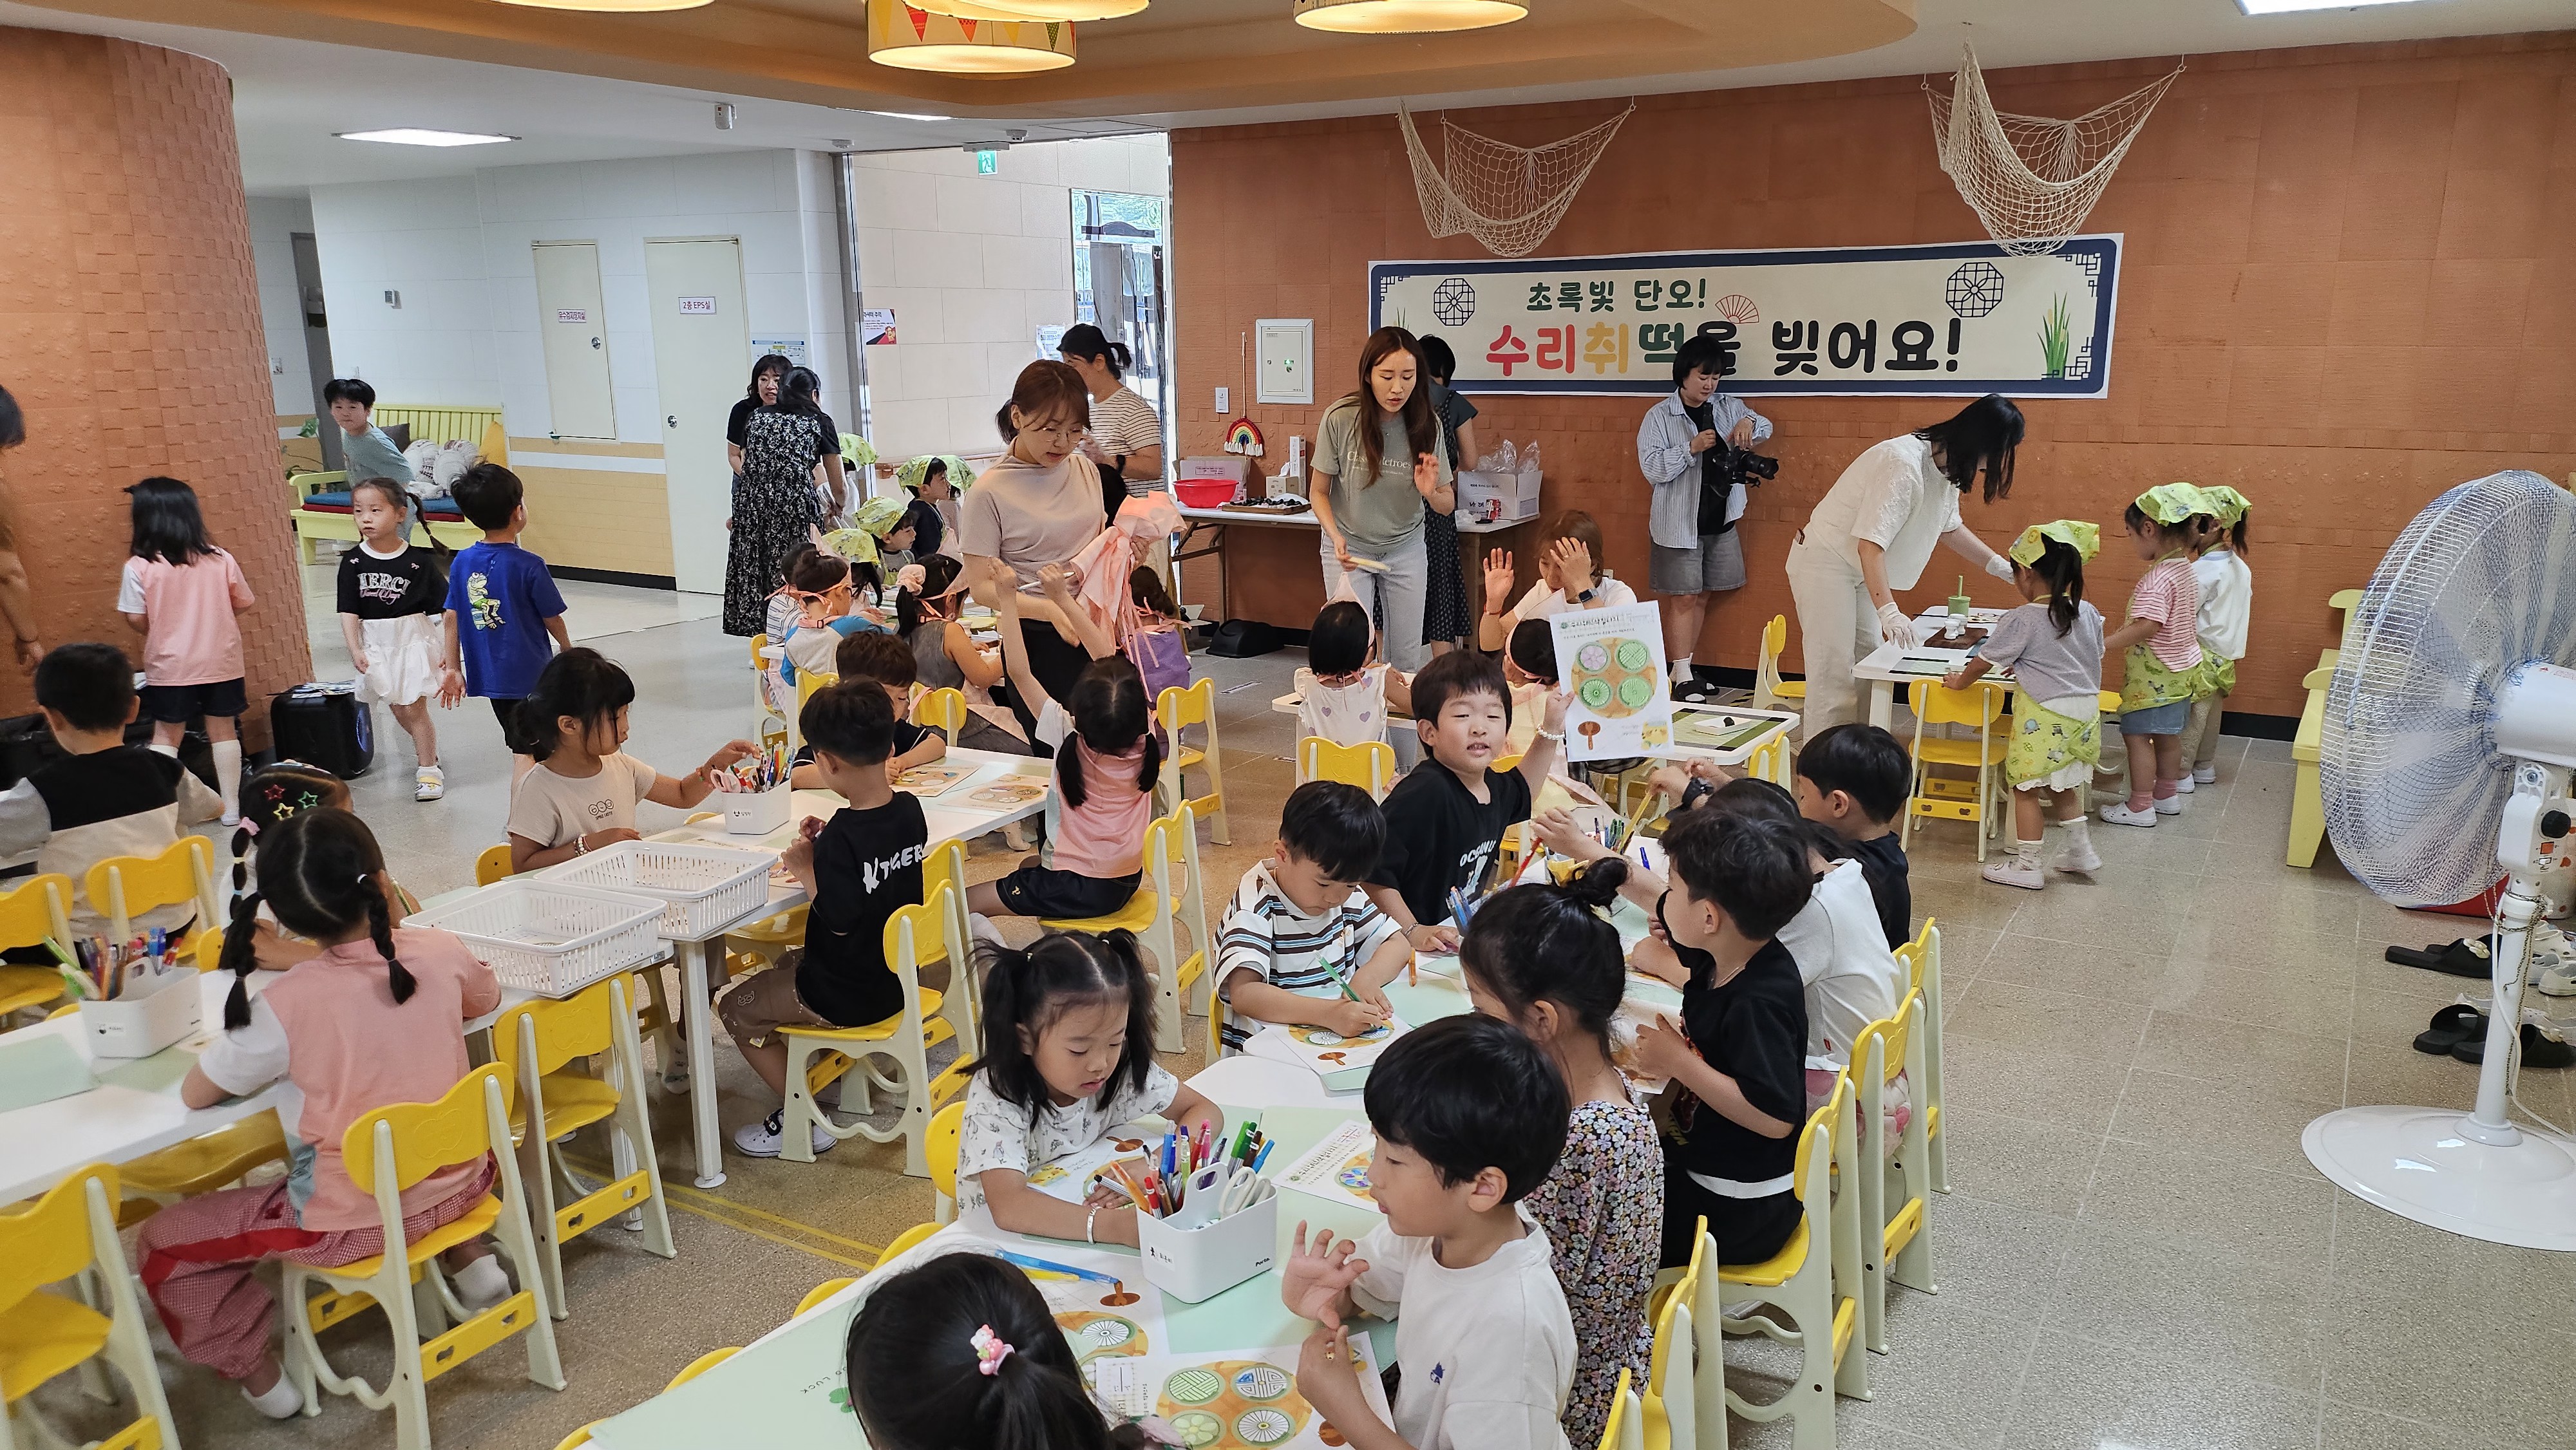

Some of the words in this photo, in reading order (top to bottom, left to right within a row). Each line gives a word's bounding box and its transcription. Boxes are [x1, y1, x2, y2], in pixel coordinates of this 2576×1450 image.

[683, 301, 692, 310] 2층
[693, 301, 711, 310] EPS실
[1526, 281, 1615, 313] 초록빛
[1634, 278, 1706, 312] 단오!
[1486, 321, 1741, 377] 수리취떡을
[1772, 317, 1962, 377] 빚어요!
